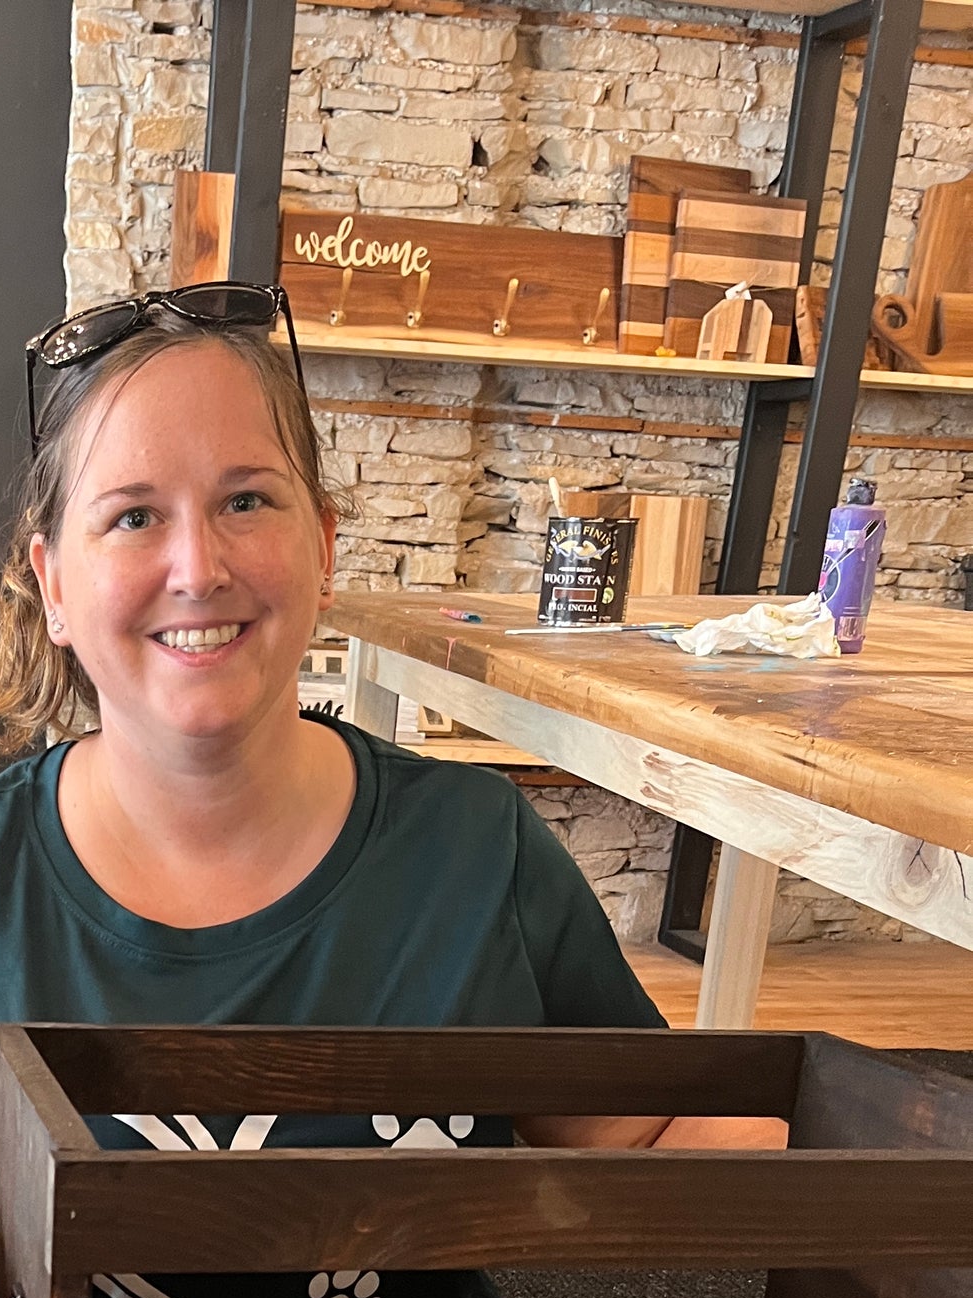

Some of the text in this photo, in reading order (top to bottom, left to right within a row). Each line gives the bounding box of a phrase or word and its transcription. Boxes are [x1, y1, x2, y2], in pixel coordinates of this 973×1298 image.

[295, 216, 431, 277] welcome
[544, 573, 615, 586] WOOD STAN
